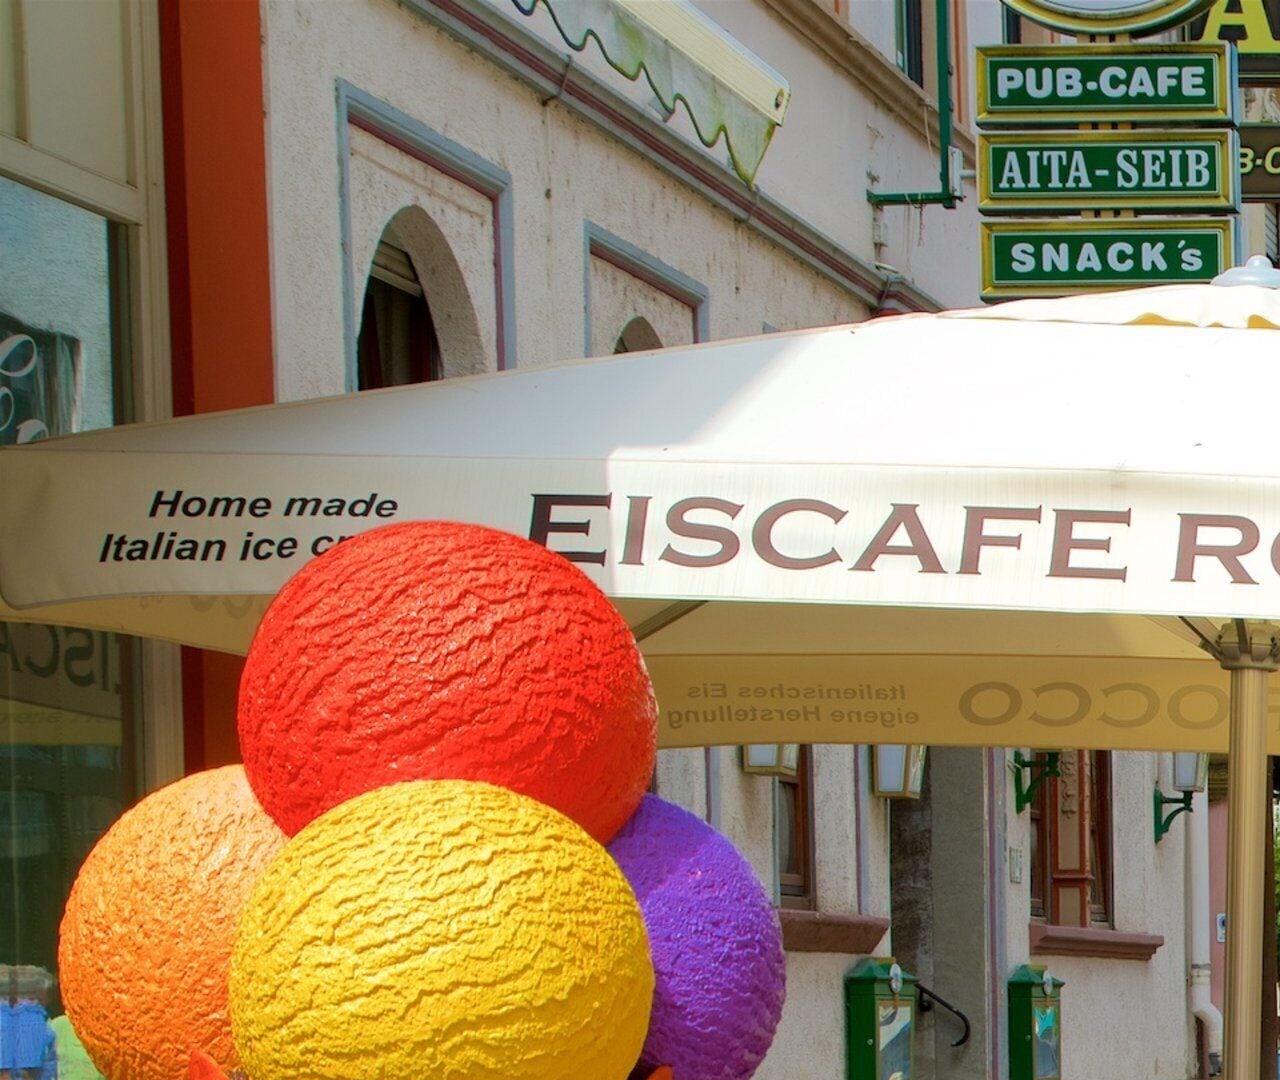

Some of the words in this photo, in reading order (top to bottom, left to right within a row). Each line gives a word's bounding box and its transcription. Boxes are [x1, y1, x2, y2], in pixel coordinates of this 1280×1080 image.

[996, 65, 1207, 99] PUB-CAFE
[148, 490, 270, 519] Home
[284, 491, 399, 518] made
[99, 531, 226, 564] Italian
[240, 531, 298, 559] ice
[528, 492, 1132, 583] EISCAFE
